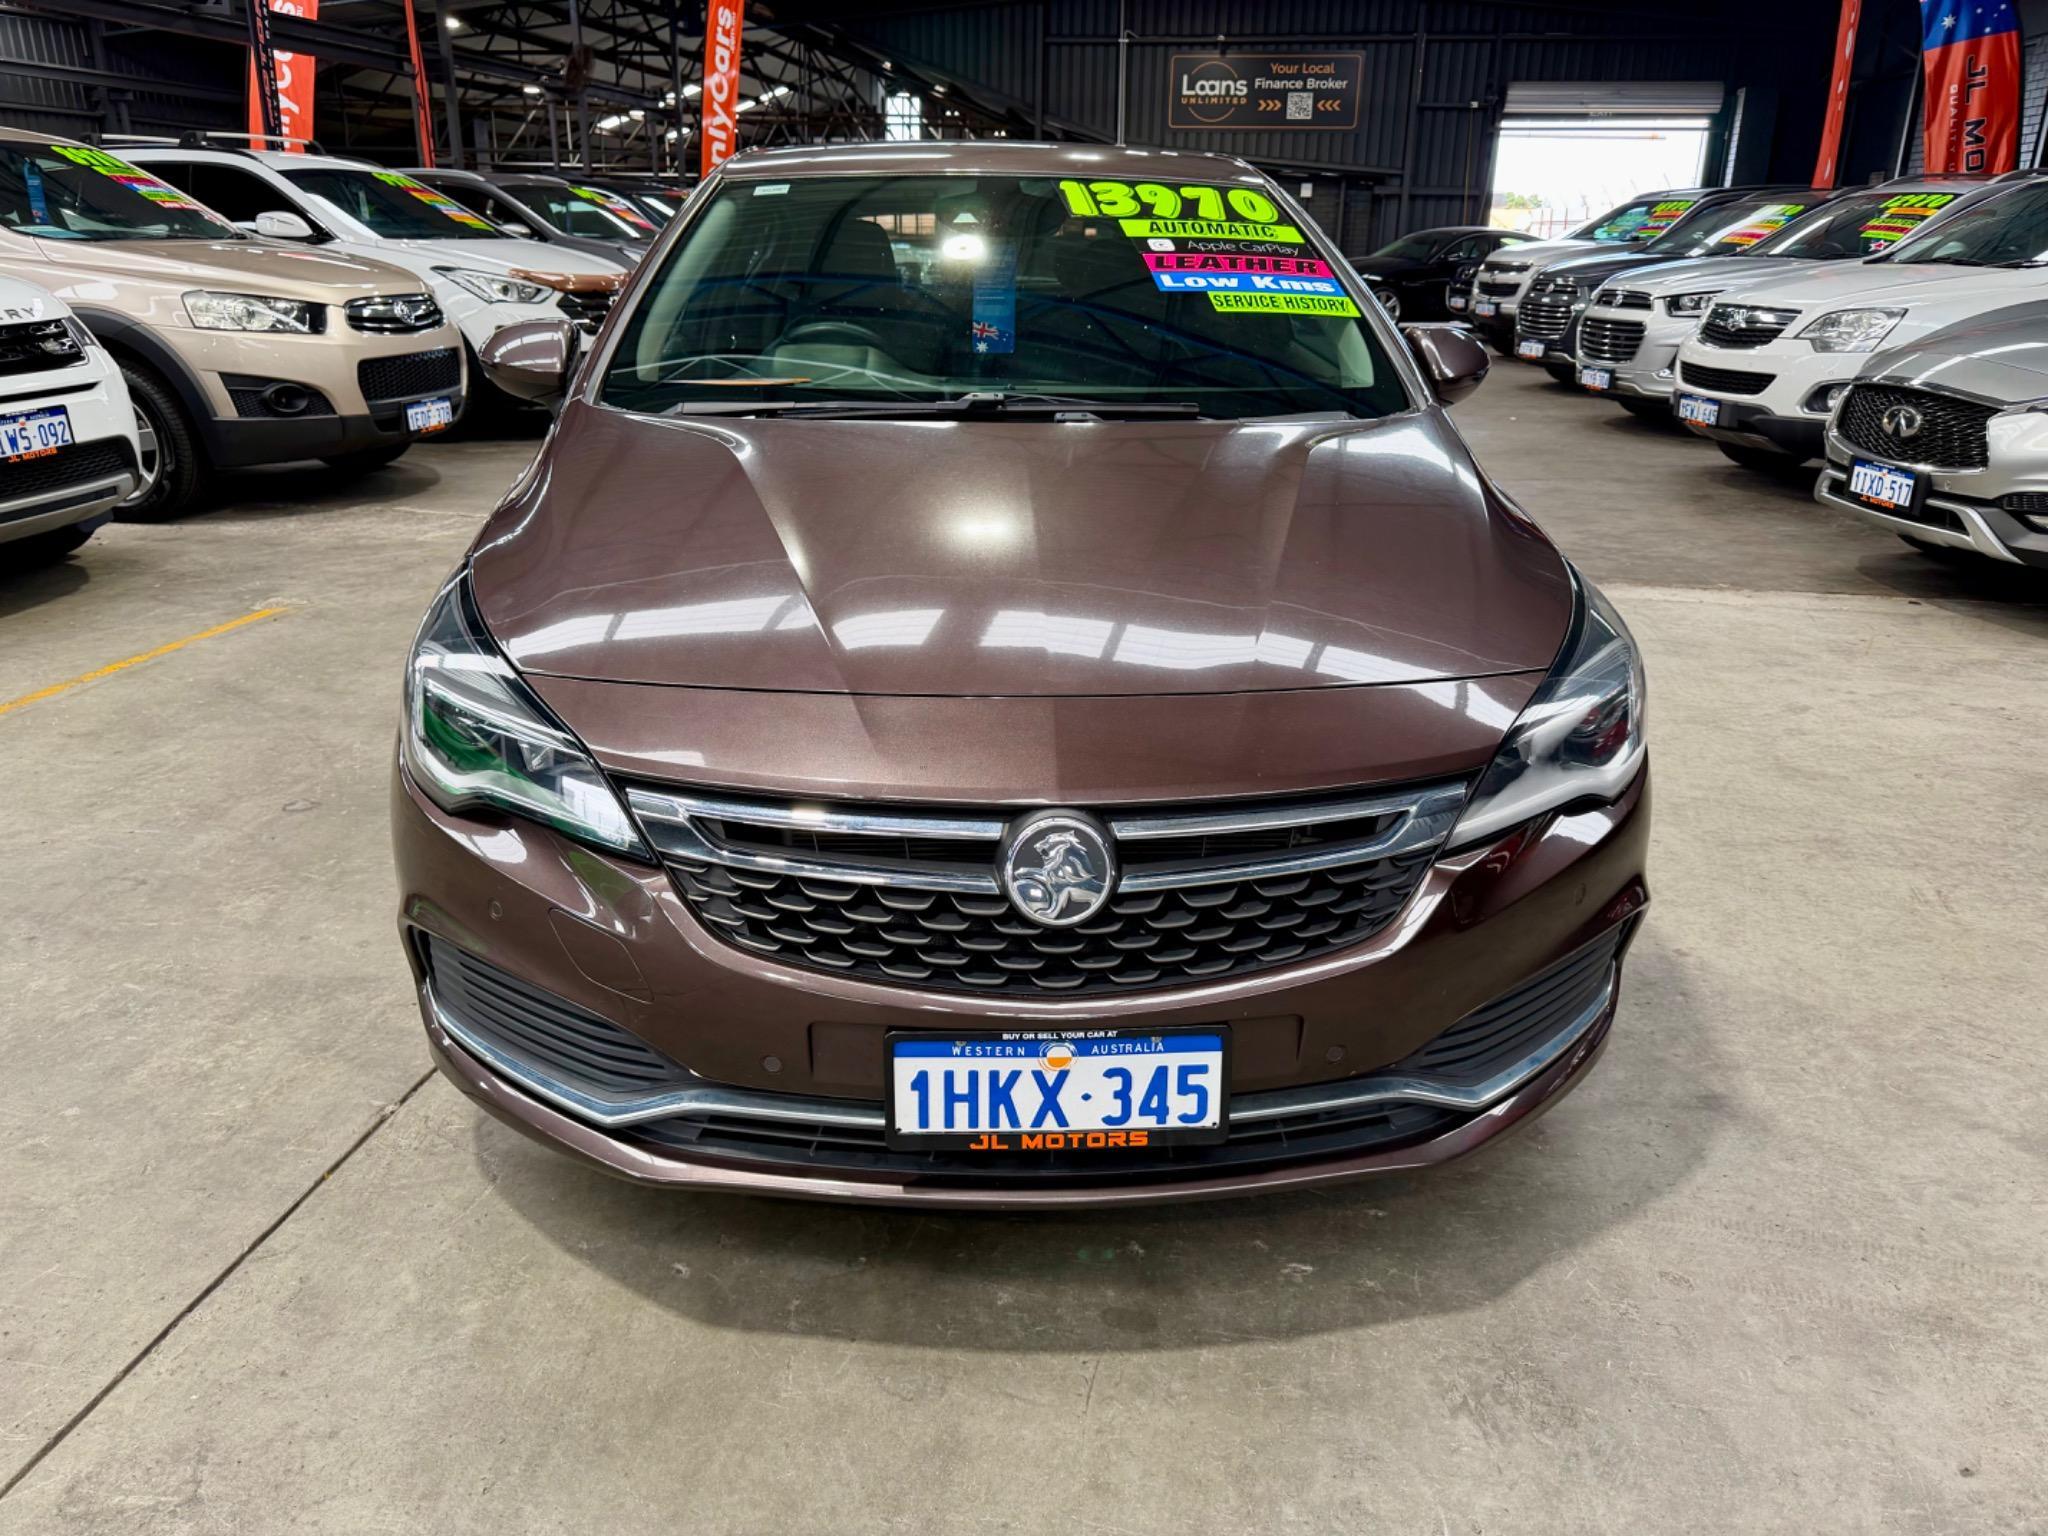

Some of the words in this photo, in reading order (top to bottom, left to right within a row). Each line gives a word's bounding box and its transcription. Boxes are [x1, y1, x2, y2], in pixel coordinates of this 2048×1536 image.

[1270, 63, 1299, 74] Your
[1302, 62, 1335, 74] Local
[1181, 74, 1248, 96] Loans
[1254, 77, 1303, 90] Finance
[1306, 78, 1348, 90] Broker
[1965, 54, 1988, 105] JL
[1181, 96, 1248, 105] UNLIMITED
[1059, 180, 1279, 223] 13970
[1149, 221, 1278, 239] AUTOMATIC
[1187, 240, 1236, 254] Apple
[1239, 241, 1300, 257] CarPlay
[1154, 255, 1319, 275] LEATHER
[1161, 274, 1238, 289] Low
[1251, 276, 1335, 293] Kms
[1211, 293, 1281, 309] SERVICE
[1284, 297, 1349, 314] HISTORY
[1061, 1031, 1085, 1039] YOUR
[1106, 1030, 1118, 1038] AT
[952, 1046, 1026, 1056] WESTERN
[1091, 1041, 1164, 1055] AUSTRALIA
[969, 1135, 1008, 1150] JL
[1021, 1131, 1149, 1149] MOTORS
